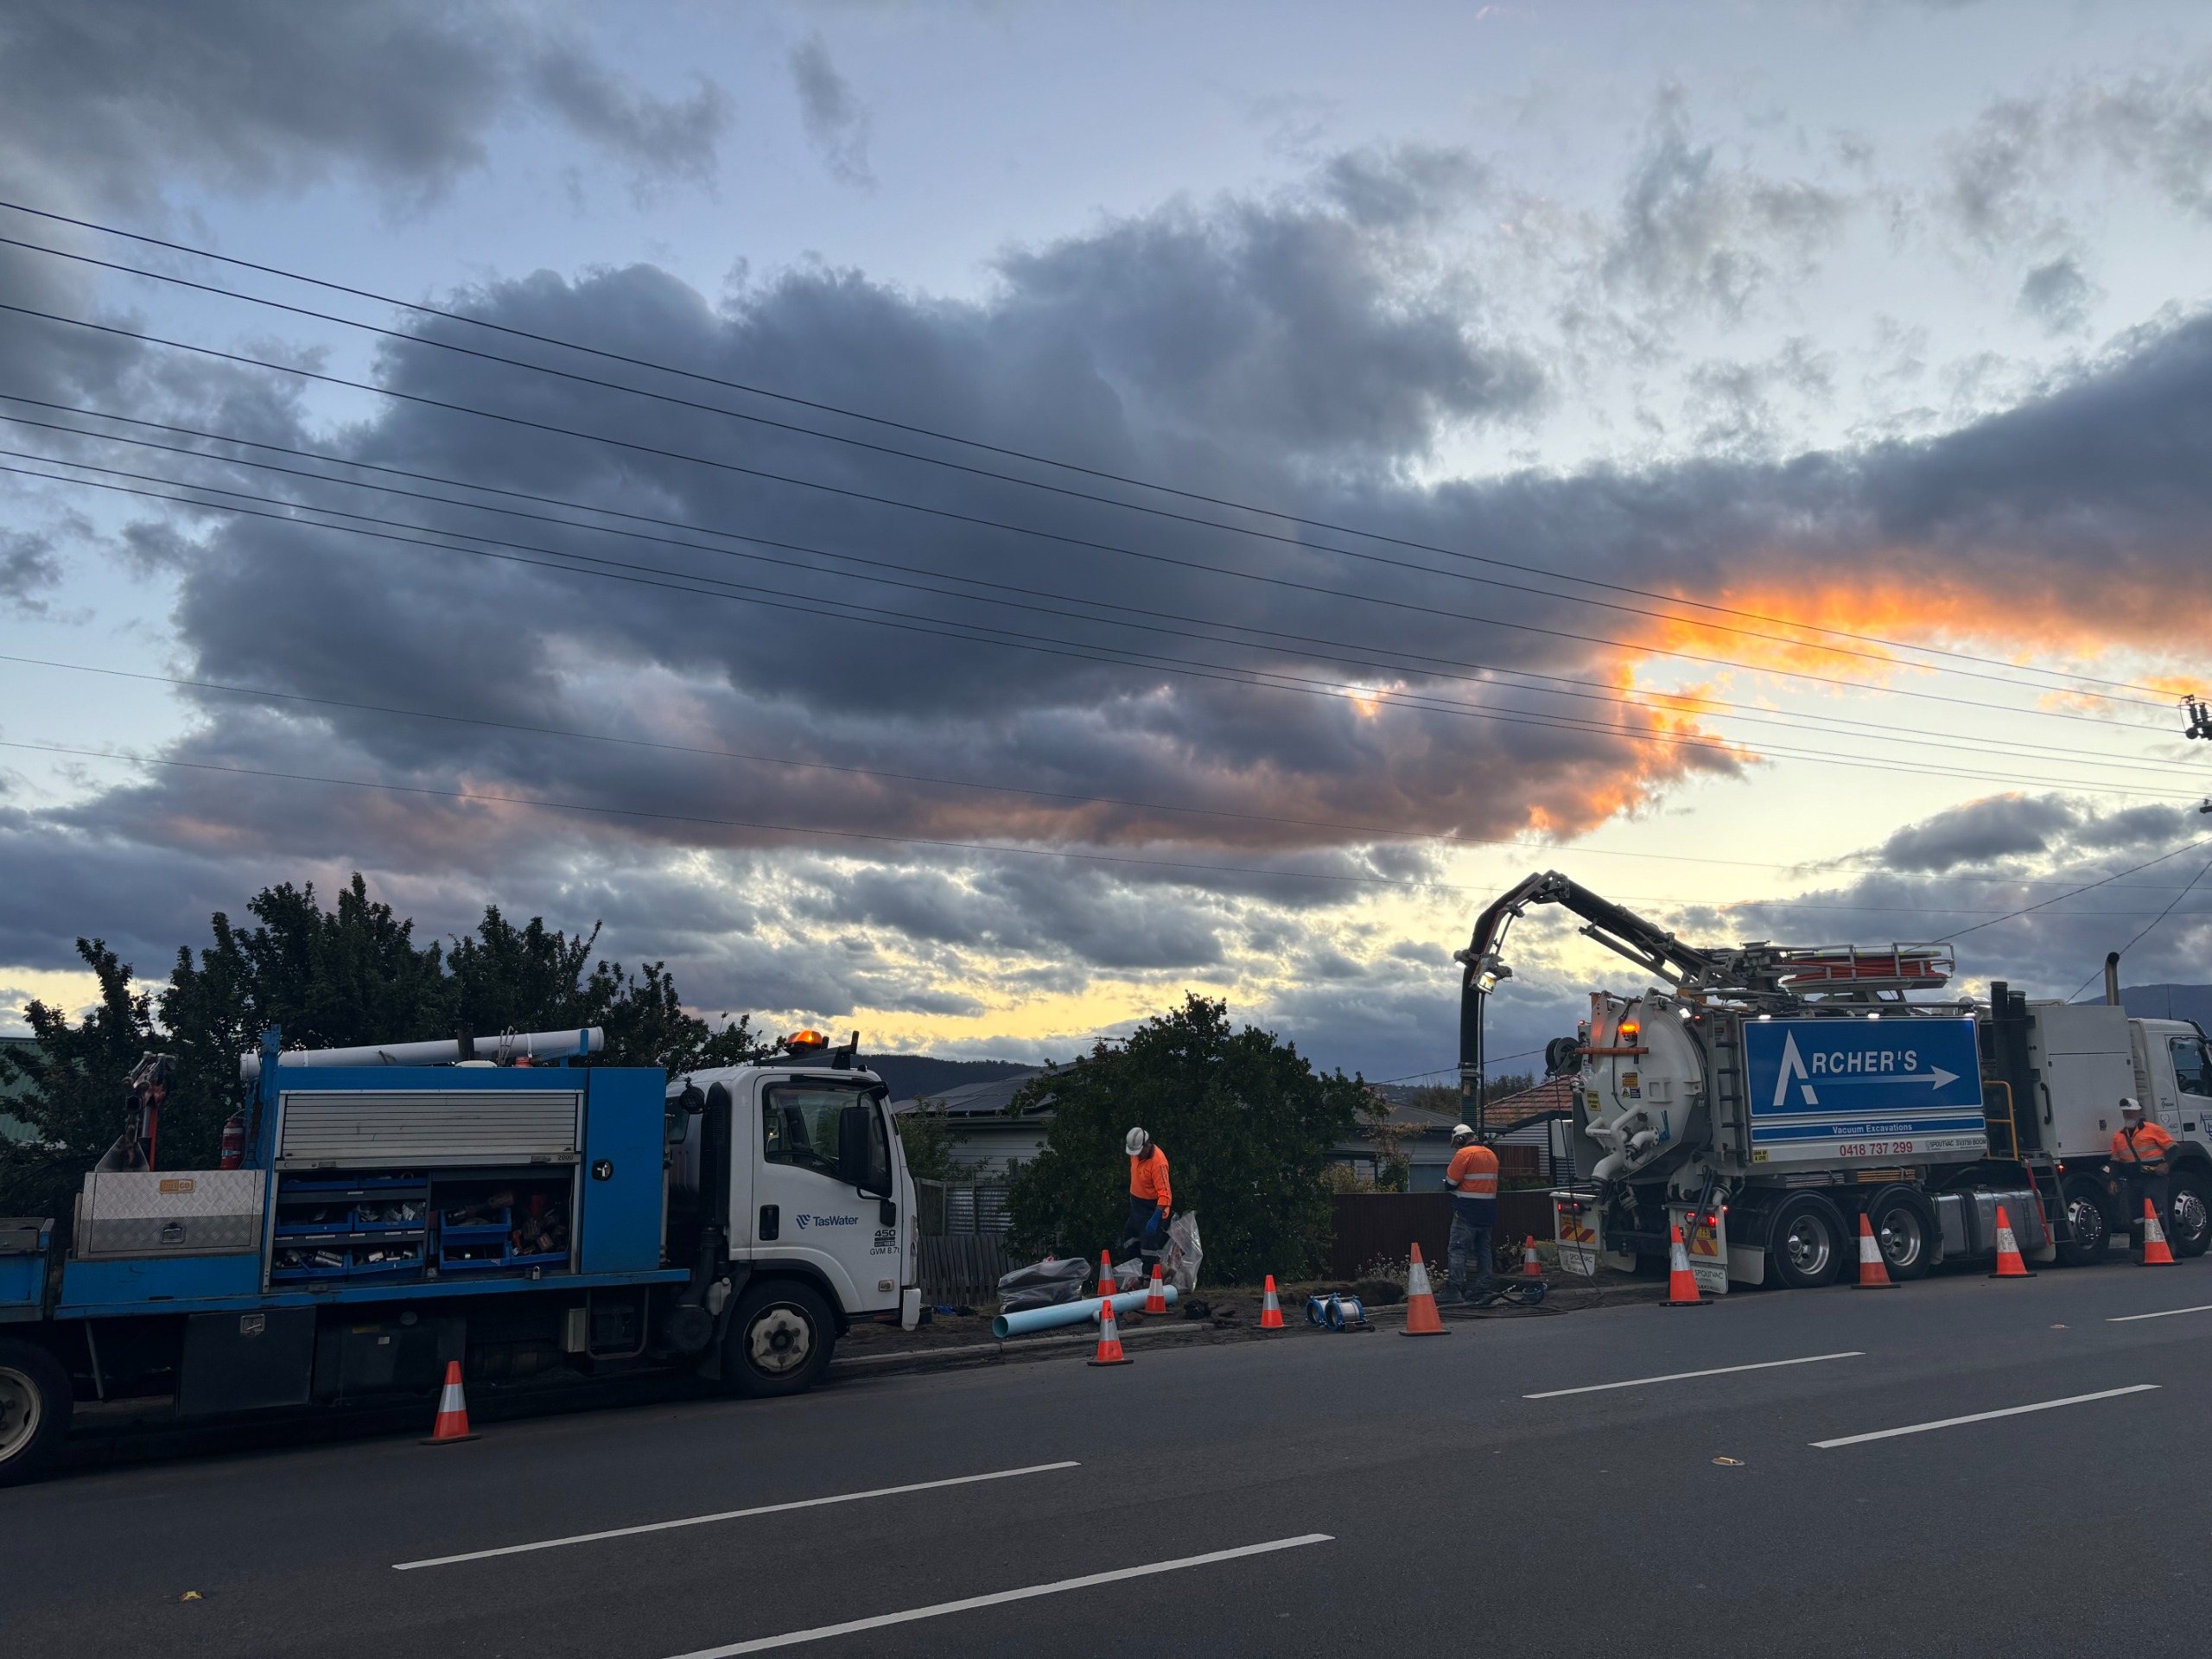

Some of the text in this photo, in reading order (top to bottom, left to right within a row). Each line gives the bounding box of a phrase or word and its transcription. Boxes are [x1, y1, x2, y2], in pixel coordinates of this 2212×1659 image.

[1772, 1028, 1918, 1107] ARCHER'S
[1832, 1123, 1913, 1135] Vacuum Excavations
[1840, 1141, 1913, 1157] 0418 737 299
[813, 1215, 859, 1227] TasWater
